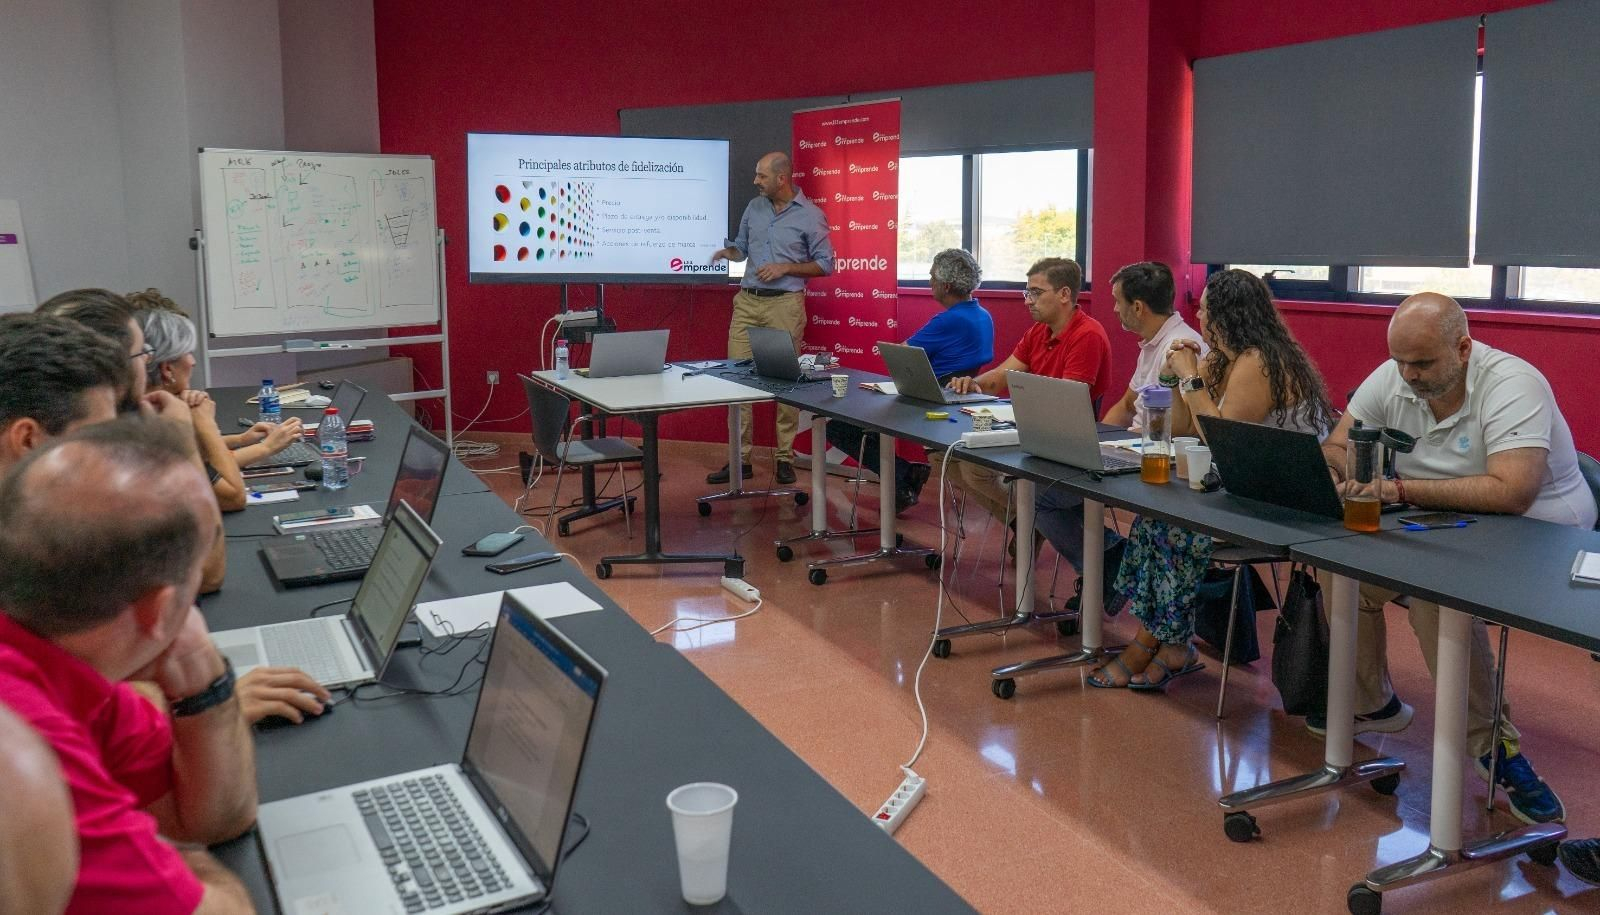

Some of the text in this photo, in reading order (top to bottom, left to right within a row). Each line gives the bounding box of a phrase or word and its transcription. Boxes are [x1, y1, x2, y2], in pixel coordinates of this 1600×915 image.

[518, 158, 684, 173] Principales atributos de fidelización
